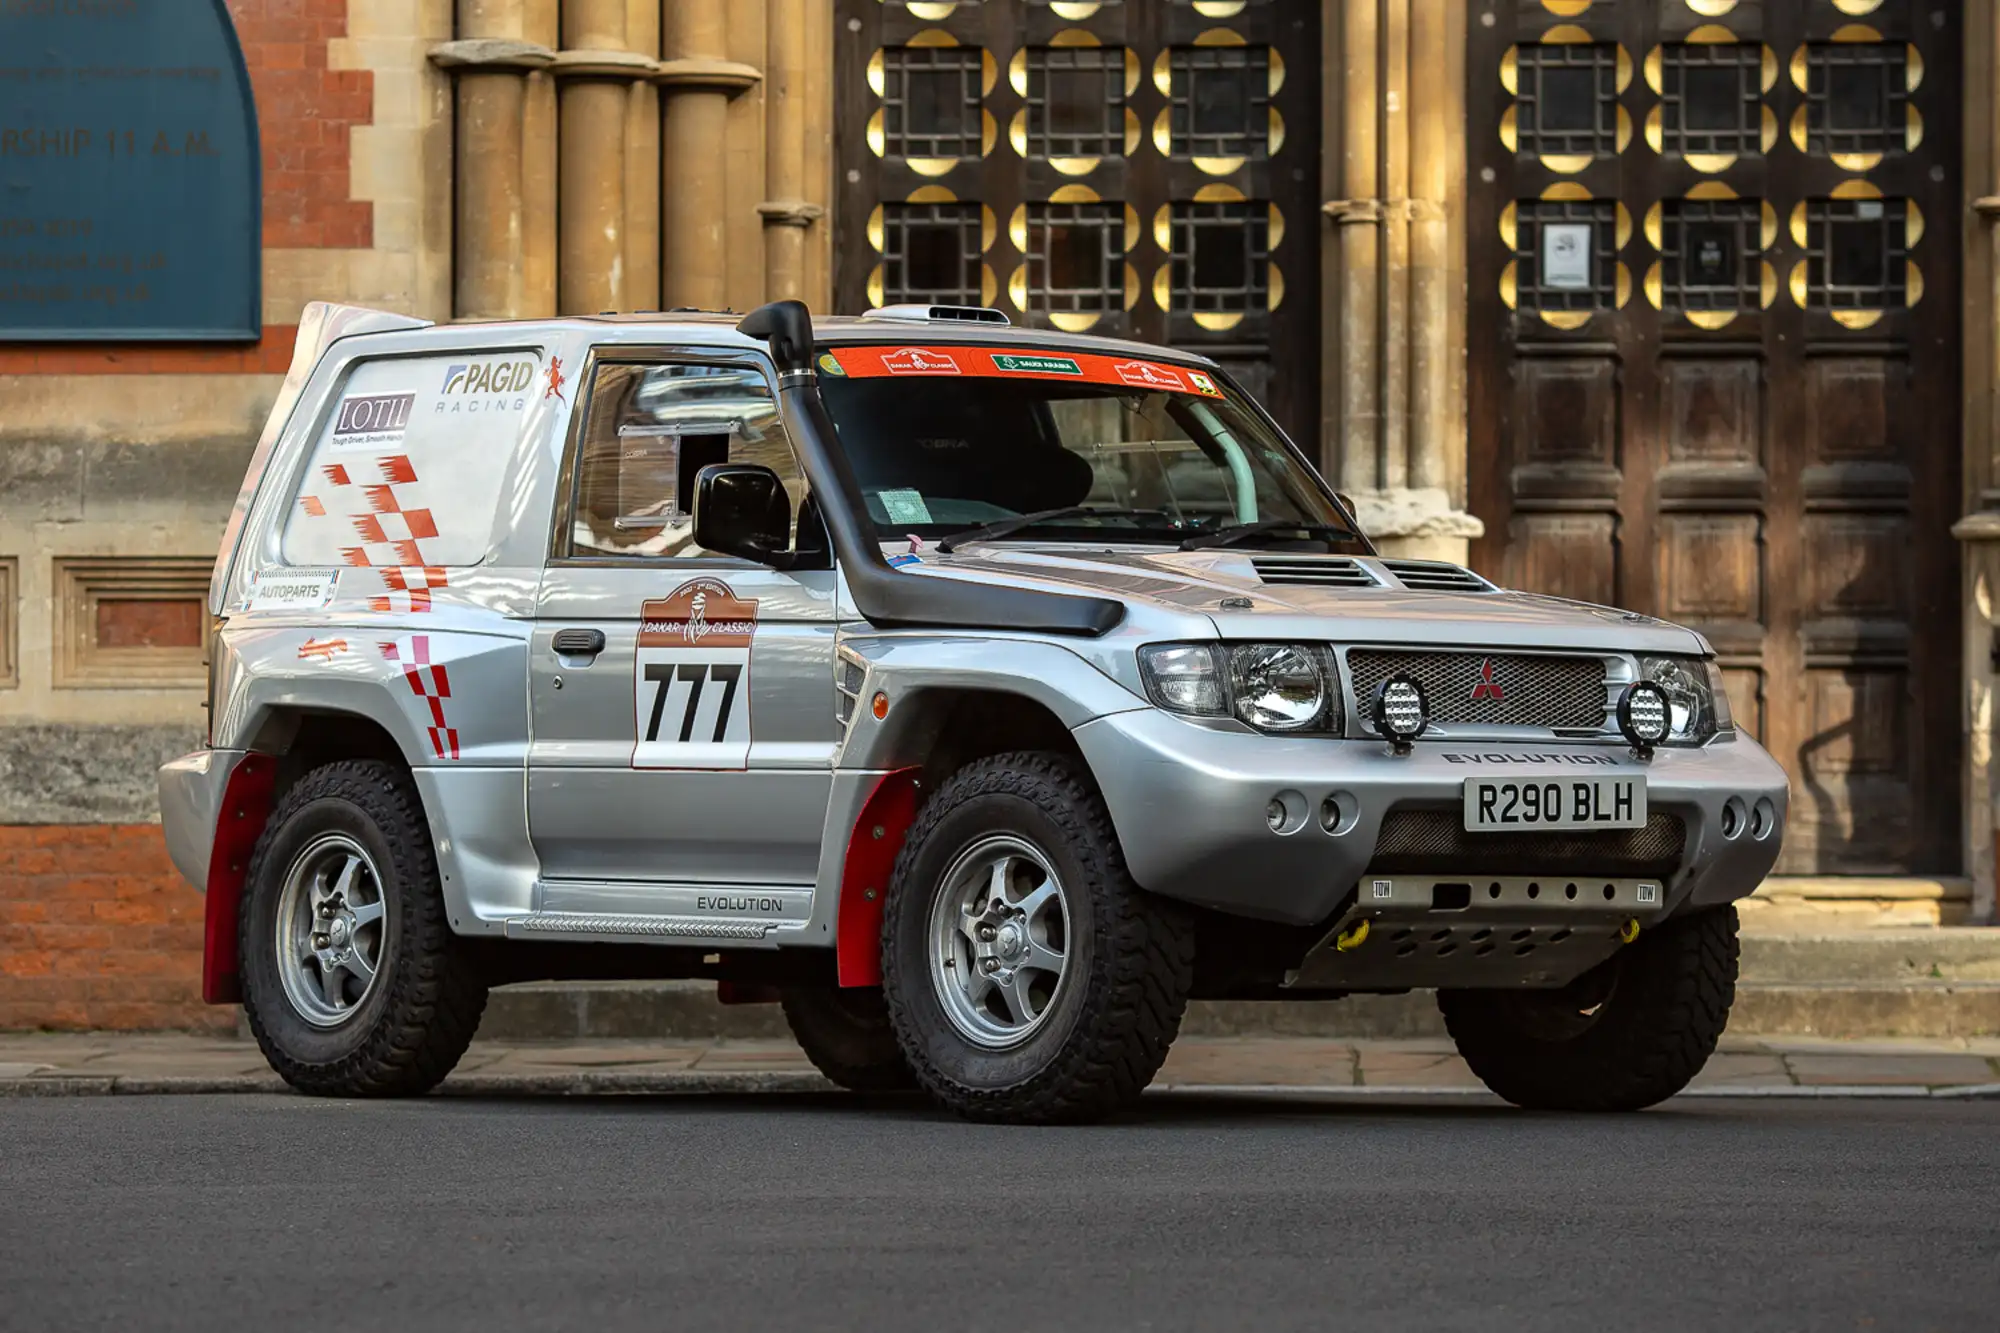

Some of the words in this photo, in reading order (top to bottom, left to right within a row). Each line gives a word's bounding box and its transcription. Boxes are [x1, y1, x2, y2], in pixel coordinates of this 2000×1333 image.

[105, 130, 135, 156] 11
[1019, 360, 1043, 368] SAUDI
[1044, 362, 1073, 370] ARABIA
[463, 361, 534, 394] PAGID
[435, 397, 524, 414] RACING
[259, 584, 321, 599] AUTOPARTS
[645, 621, 679, 633] DAKAR
[712, 621, 752, 633] CLASSIC
[644, 663, 743, 743] 777
[1441, 753, 1619, 766] EVOLUTION
[1479, 783, 1561, 824] R290
[1572, 782, 1634, 822] BLH
[1374, 882, 1391, 897] TOW
[1638, 886, 1655, 901] TOW
[697, 896, 783, 912] EVOLUTION
